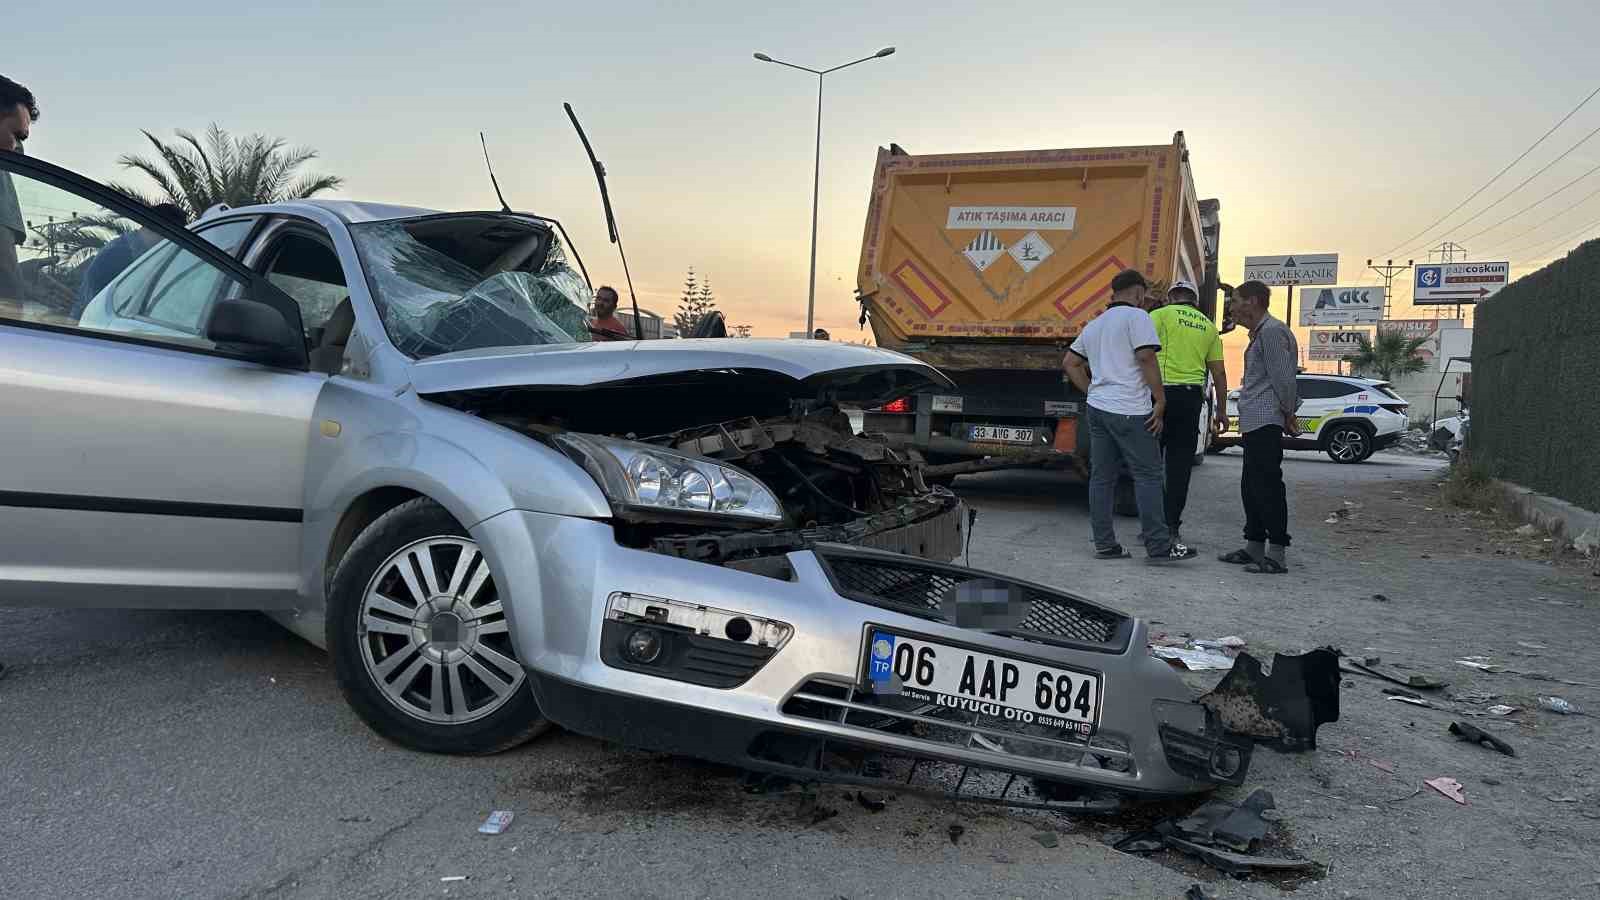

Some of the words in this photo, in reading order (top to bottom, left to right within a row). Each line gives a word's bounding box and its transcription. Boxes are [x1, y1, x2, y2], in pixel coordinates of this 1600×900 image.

[957, 211, 982, 222] ATIK
[986, 211, 1027, 224] TAŞIMA
[1030, 211, 1066, 222] ARACI
[974, 427, 985, 438] 33
[1015, 429, 1032, 441] 307
[874, 661, 889, 673] TR
[894, 642, 936, 687] 06
[958, 655, 1019, 702] AAP
[1035, 671, 1091, 718] 684
[936, 693, 1000, 717] KUYUCU
[1004, 707, 1034, 724] OTO
